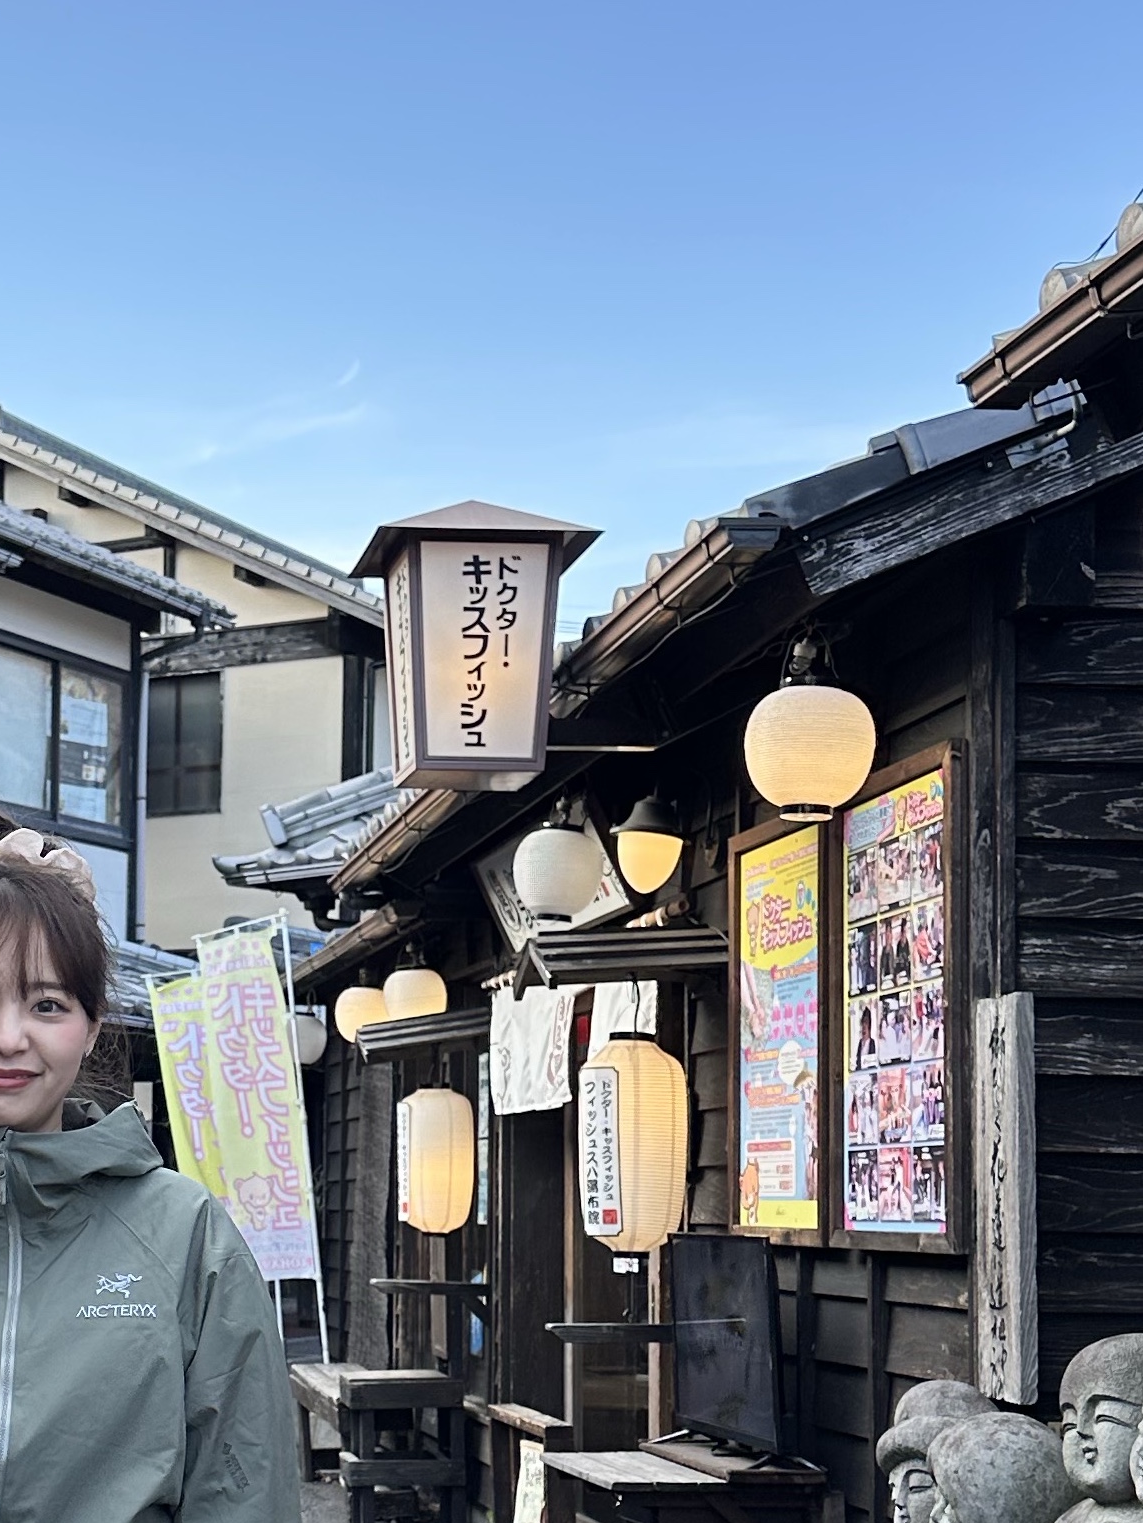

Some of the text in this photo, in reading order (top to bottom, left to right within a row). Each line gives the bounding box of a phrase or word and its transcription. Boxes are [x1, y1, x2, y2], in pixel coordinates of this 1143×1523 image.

[461, 555, 491, 747] キッスフィッシュ
